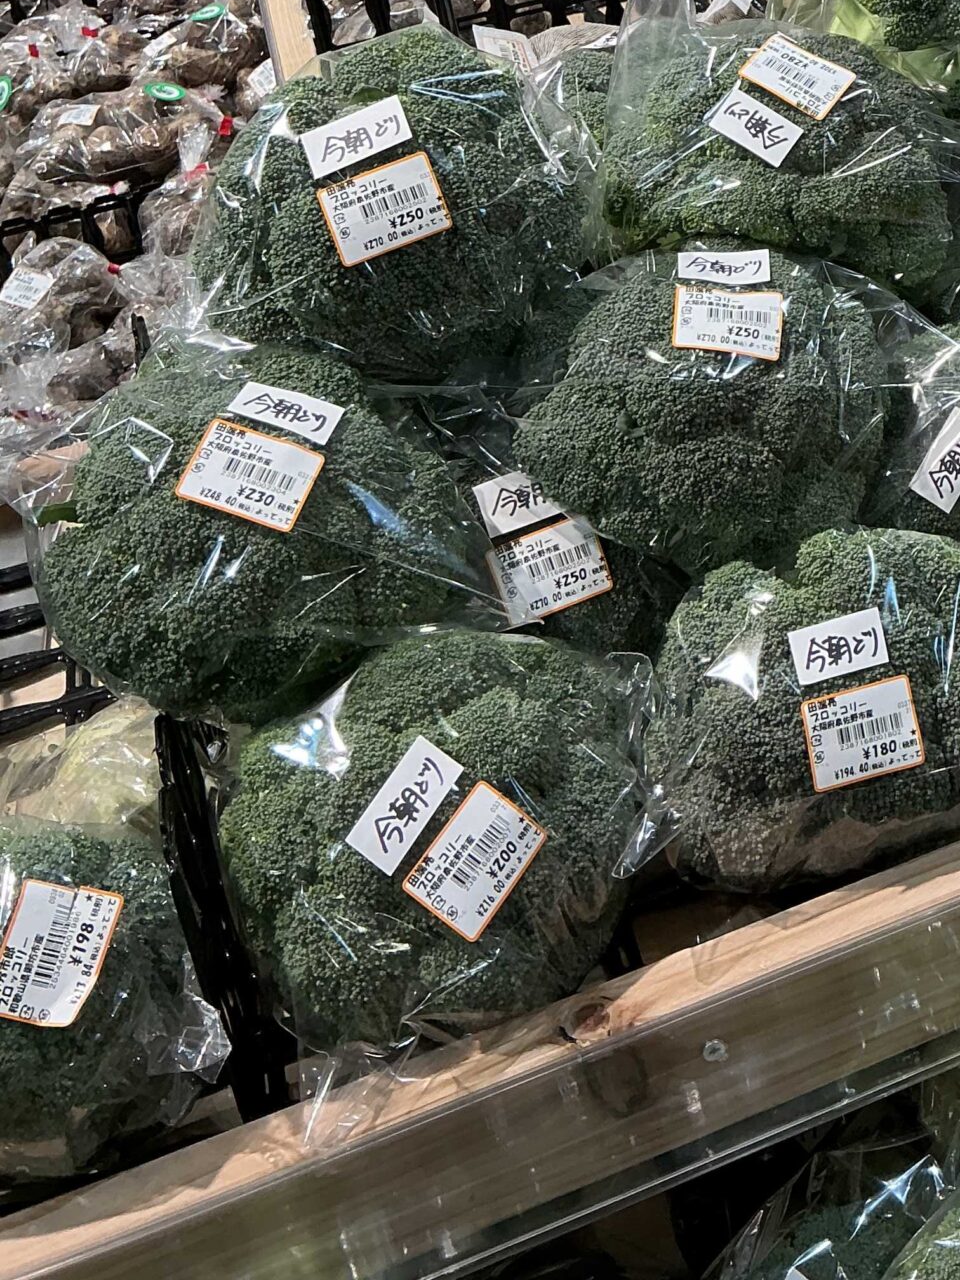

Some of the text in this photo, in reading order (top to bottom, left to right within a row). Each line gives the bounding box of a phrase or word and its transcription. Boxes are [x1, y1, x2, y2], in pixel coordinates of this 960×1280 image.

[779, 50, 809, 70] ¥280
[387, 206, 425, 230] ¥250
[728, 325, 759, 338] ¥250
[235, 484, 275, 507] ¥230
[553, 567, 587, 589] ¥250
[806, 627, 879, 672] 今朝どり
[861, 738, 897, 761] ¥180
[485, 839, 518, 881] ¥200
[66, 921, 97, 967] ¥198
